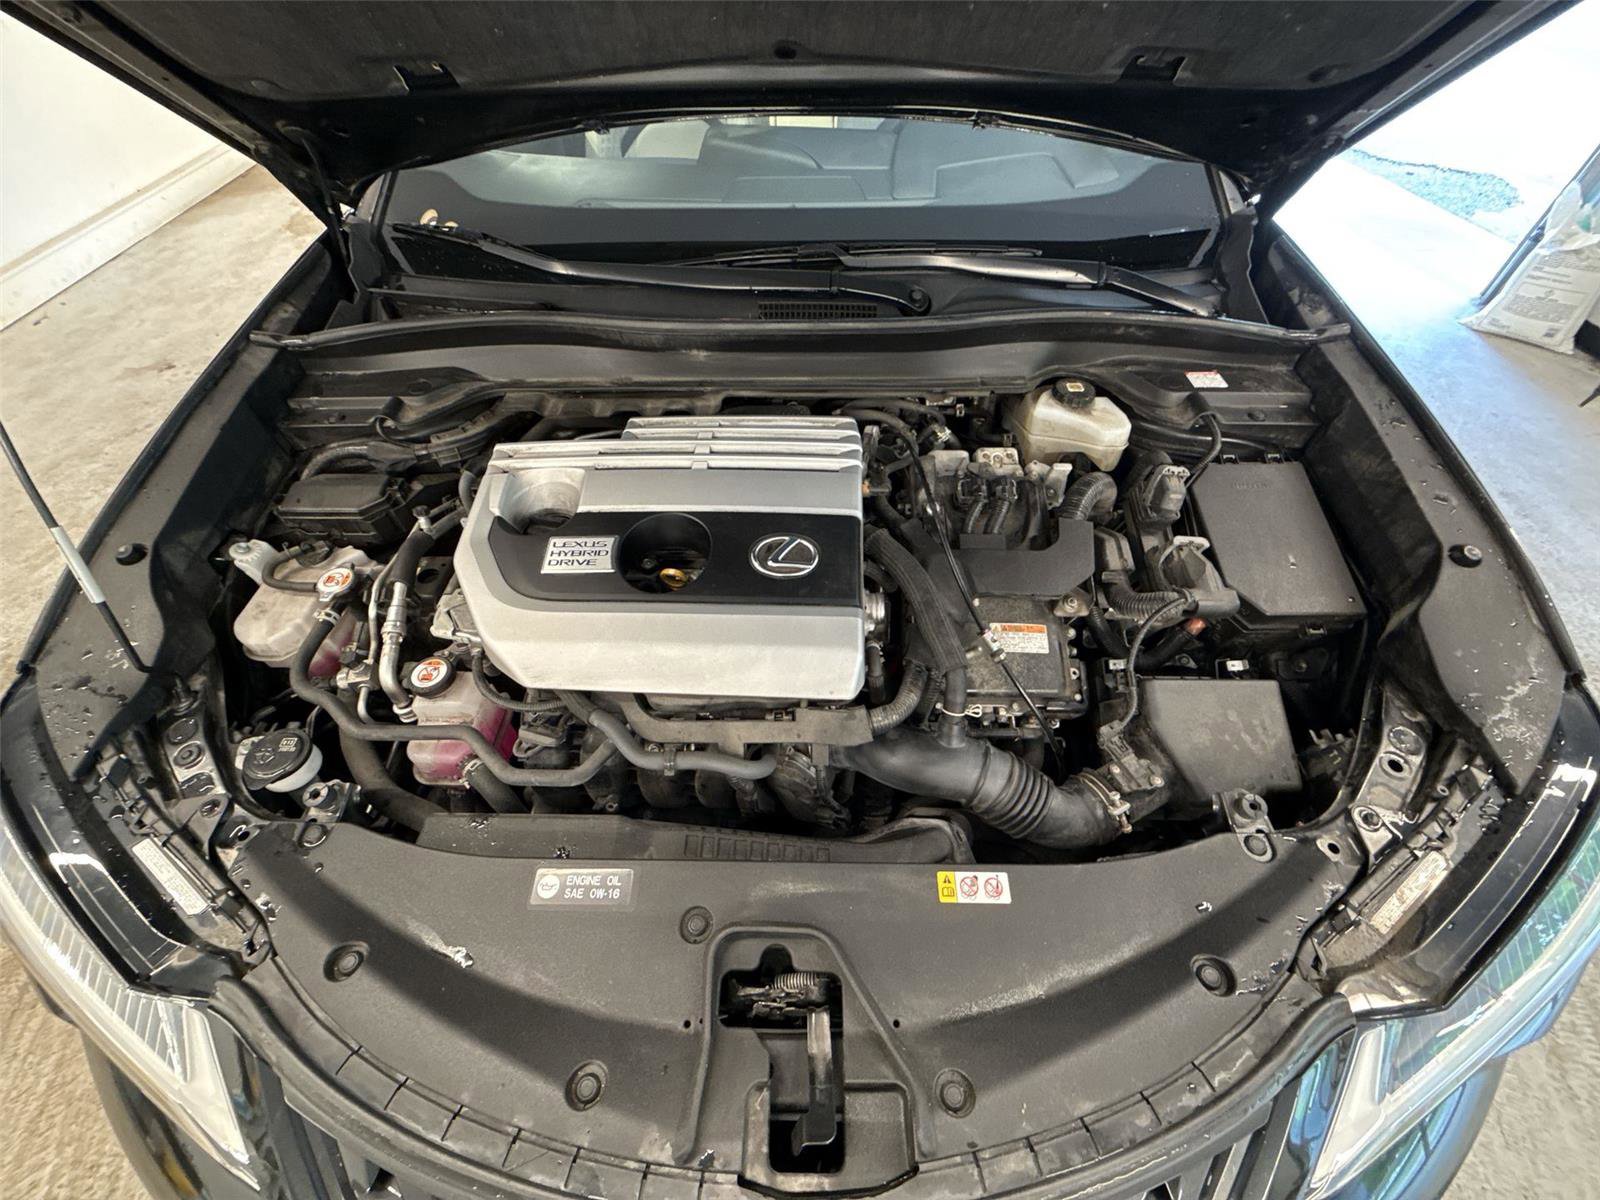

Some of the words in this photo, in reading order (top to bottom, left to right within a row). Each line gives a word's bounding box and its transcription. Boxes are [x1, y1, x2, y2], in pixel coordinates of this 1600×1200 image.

[566, 875, 602, 886] ENGINE
[607, 875, 622, 886] OIL
[564, 888, 585, 899] SAE
[590, 888, 620, 899] 0W-16
